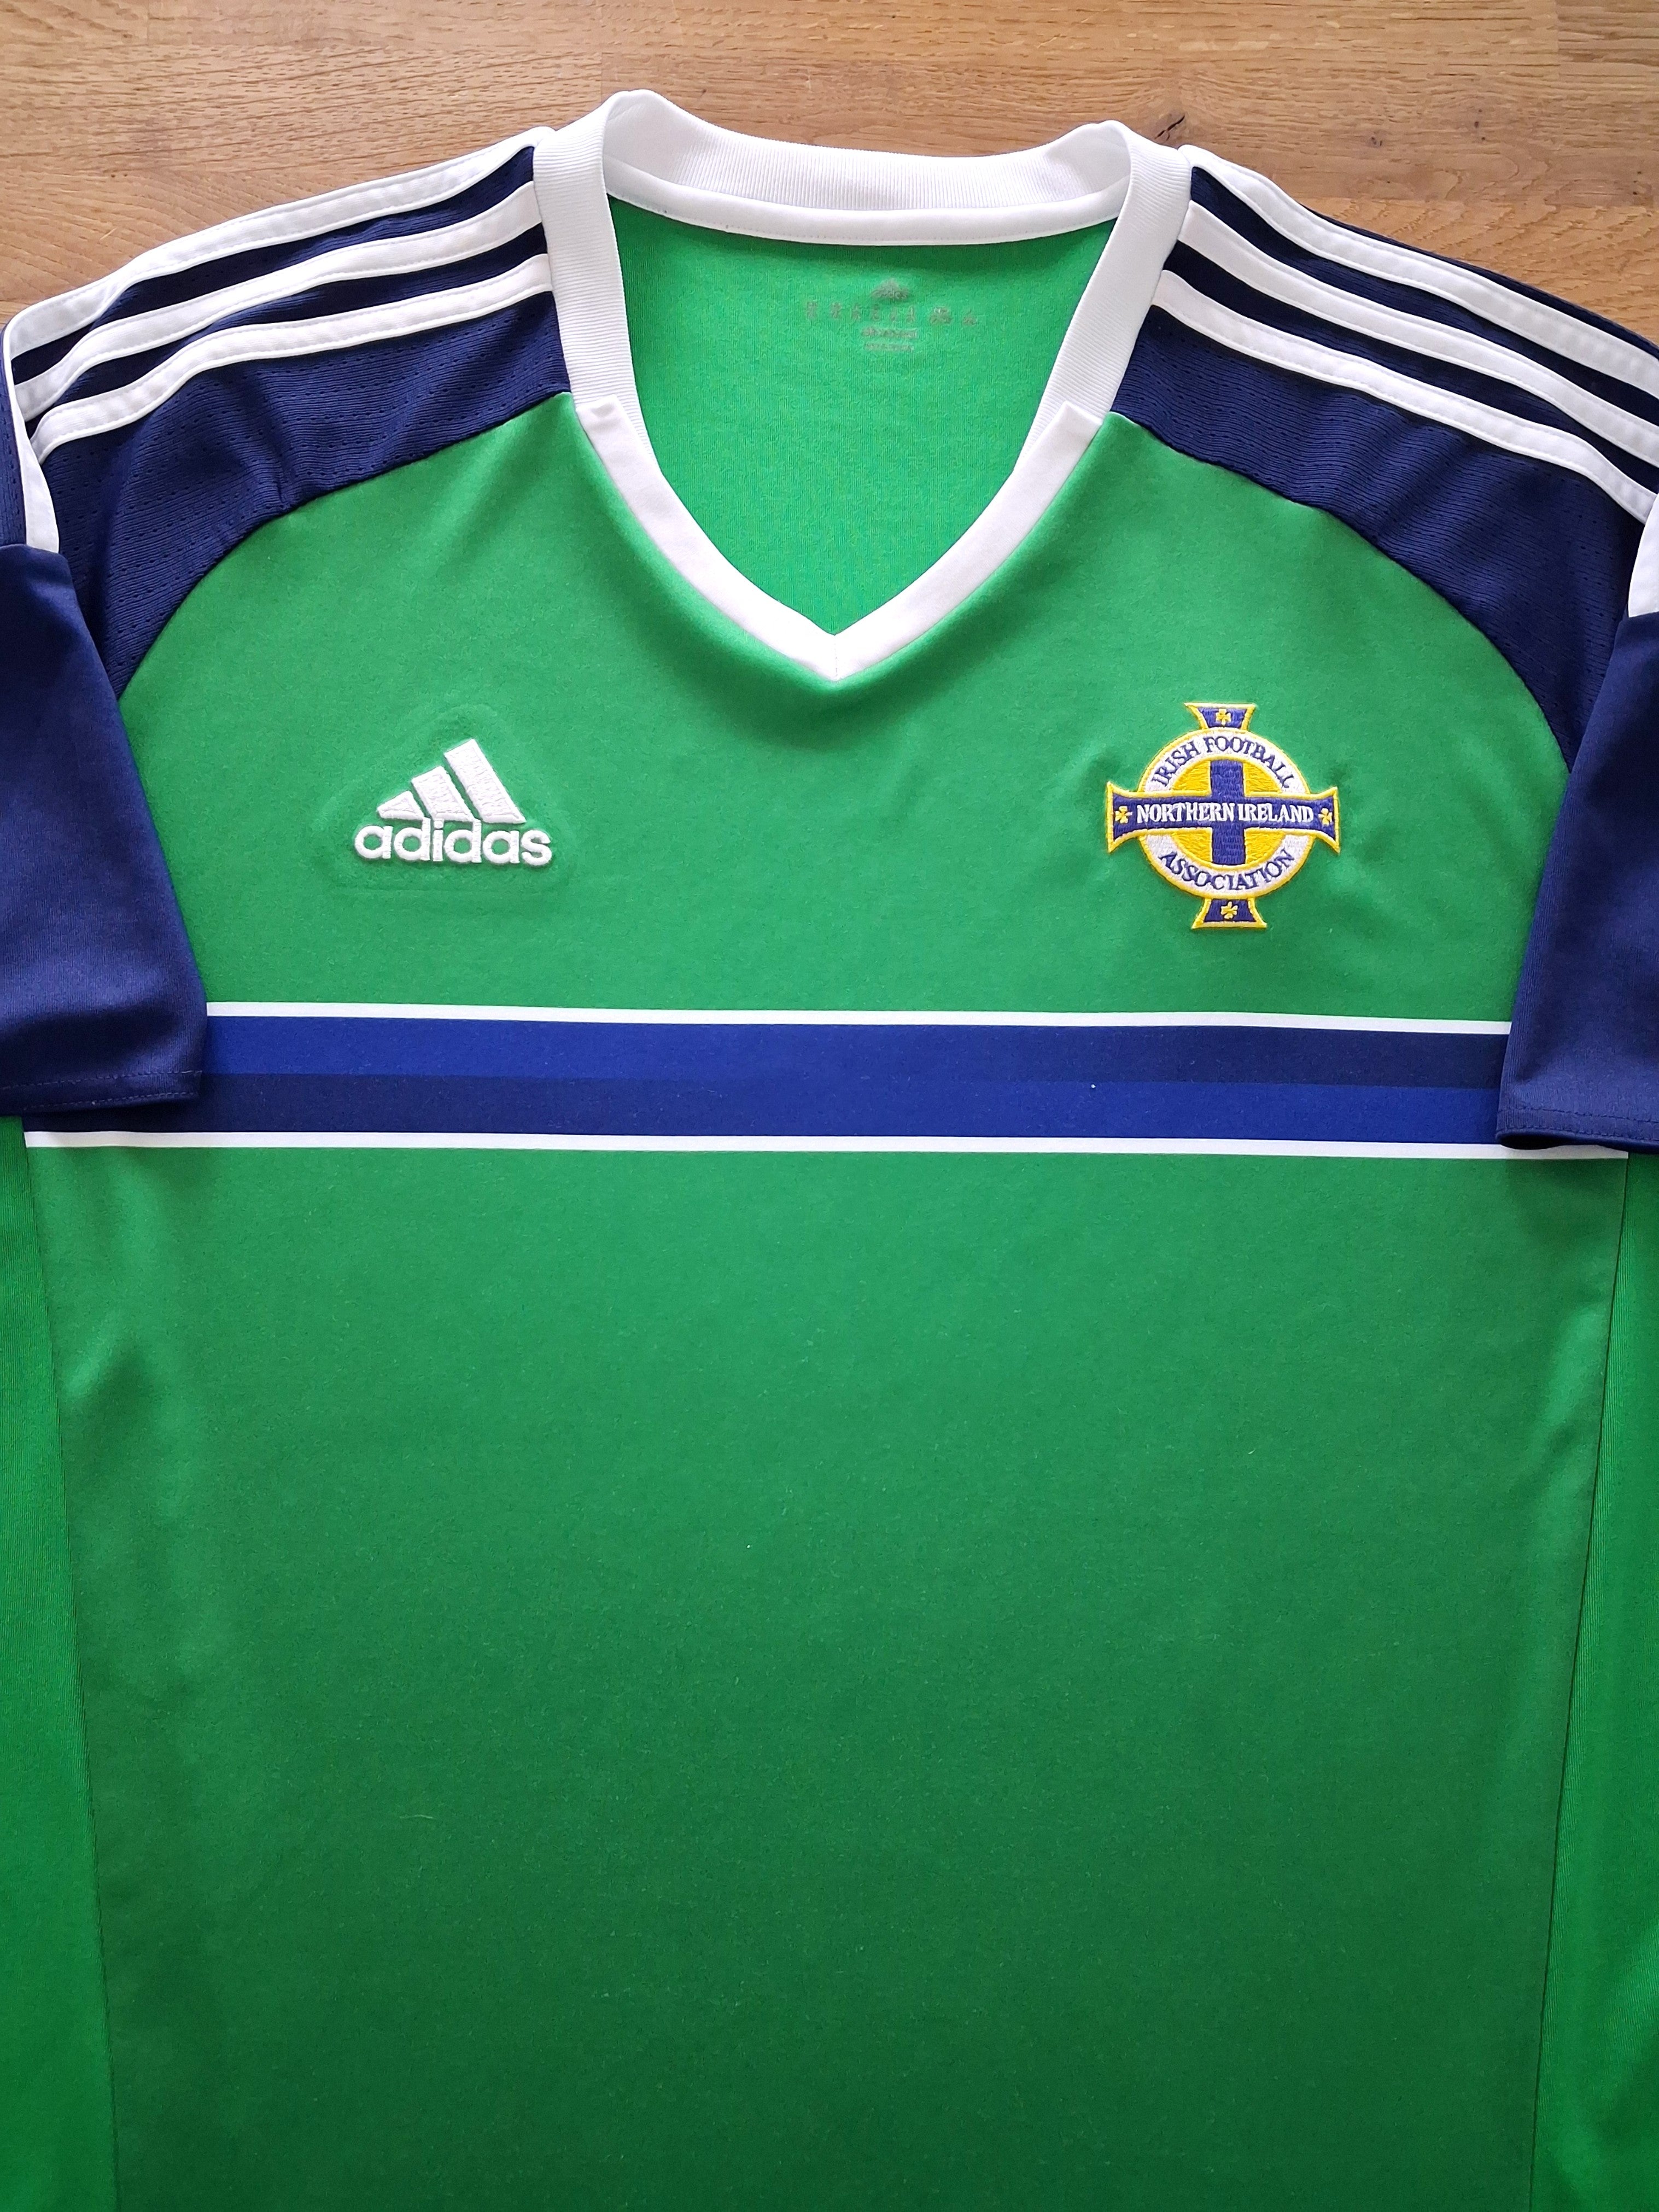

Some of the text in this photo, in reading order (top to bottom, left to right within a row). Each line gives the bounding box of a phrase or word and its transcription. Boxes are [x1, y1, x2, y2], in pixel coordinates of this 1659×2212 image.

[1152, 736, 1295, 788] IRISH FOOTBALL
[1137, 802, 1314, 823] NORTHERN IRELAND
[355, 818, 552, 866] adidas
[1159, 849, 1294, 890] ASSOCIATION
